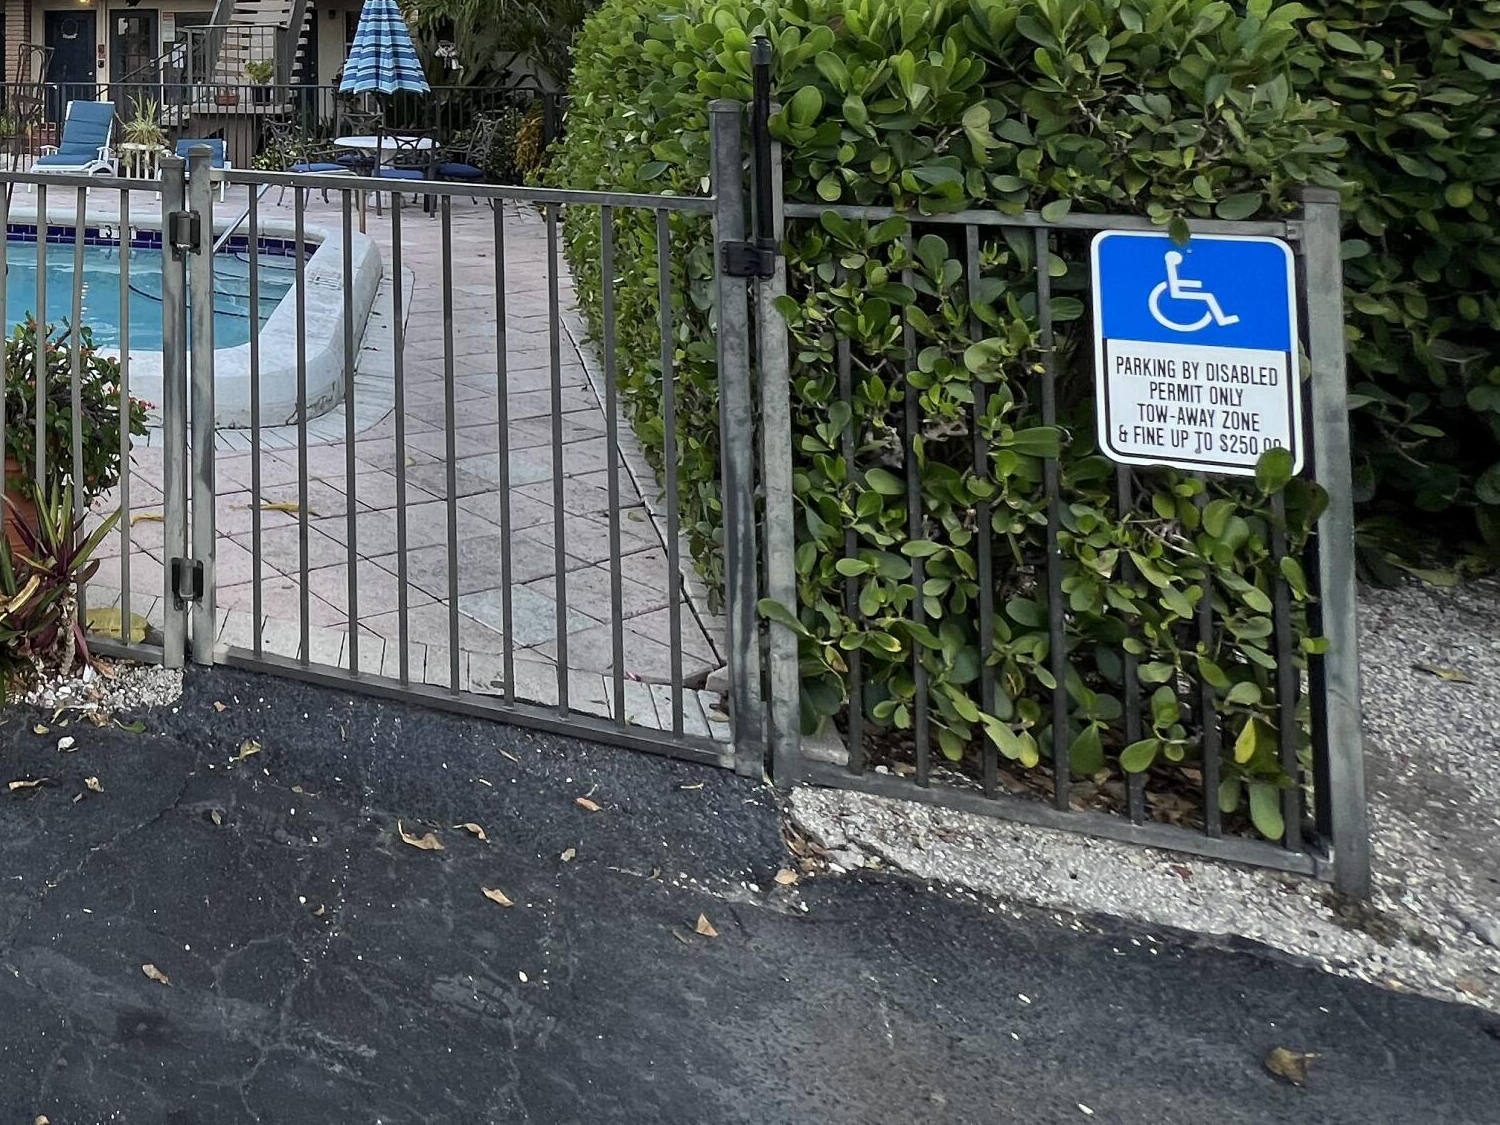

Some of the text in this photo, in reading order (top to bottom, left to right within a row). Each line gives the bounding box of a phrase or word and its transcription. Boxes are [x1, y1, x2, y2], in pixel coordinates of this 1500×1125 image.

[104, 224, 113, 238] 3
[1116, 355, 1278, 387] PARKING BY DISABLED
[1149, 381, 1243, 407] PERMIT ONLY
[1137, 403, 1260, 432] TOW-AWAY ZONE
[1118, 424, 1282, 456] & FINE UP TO $2500
